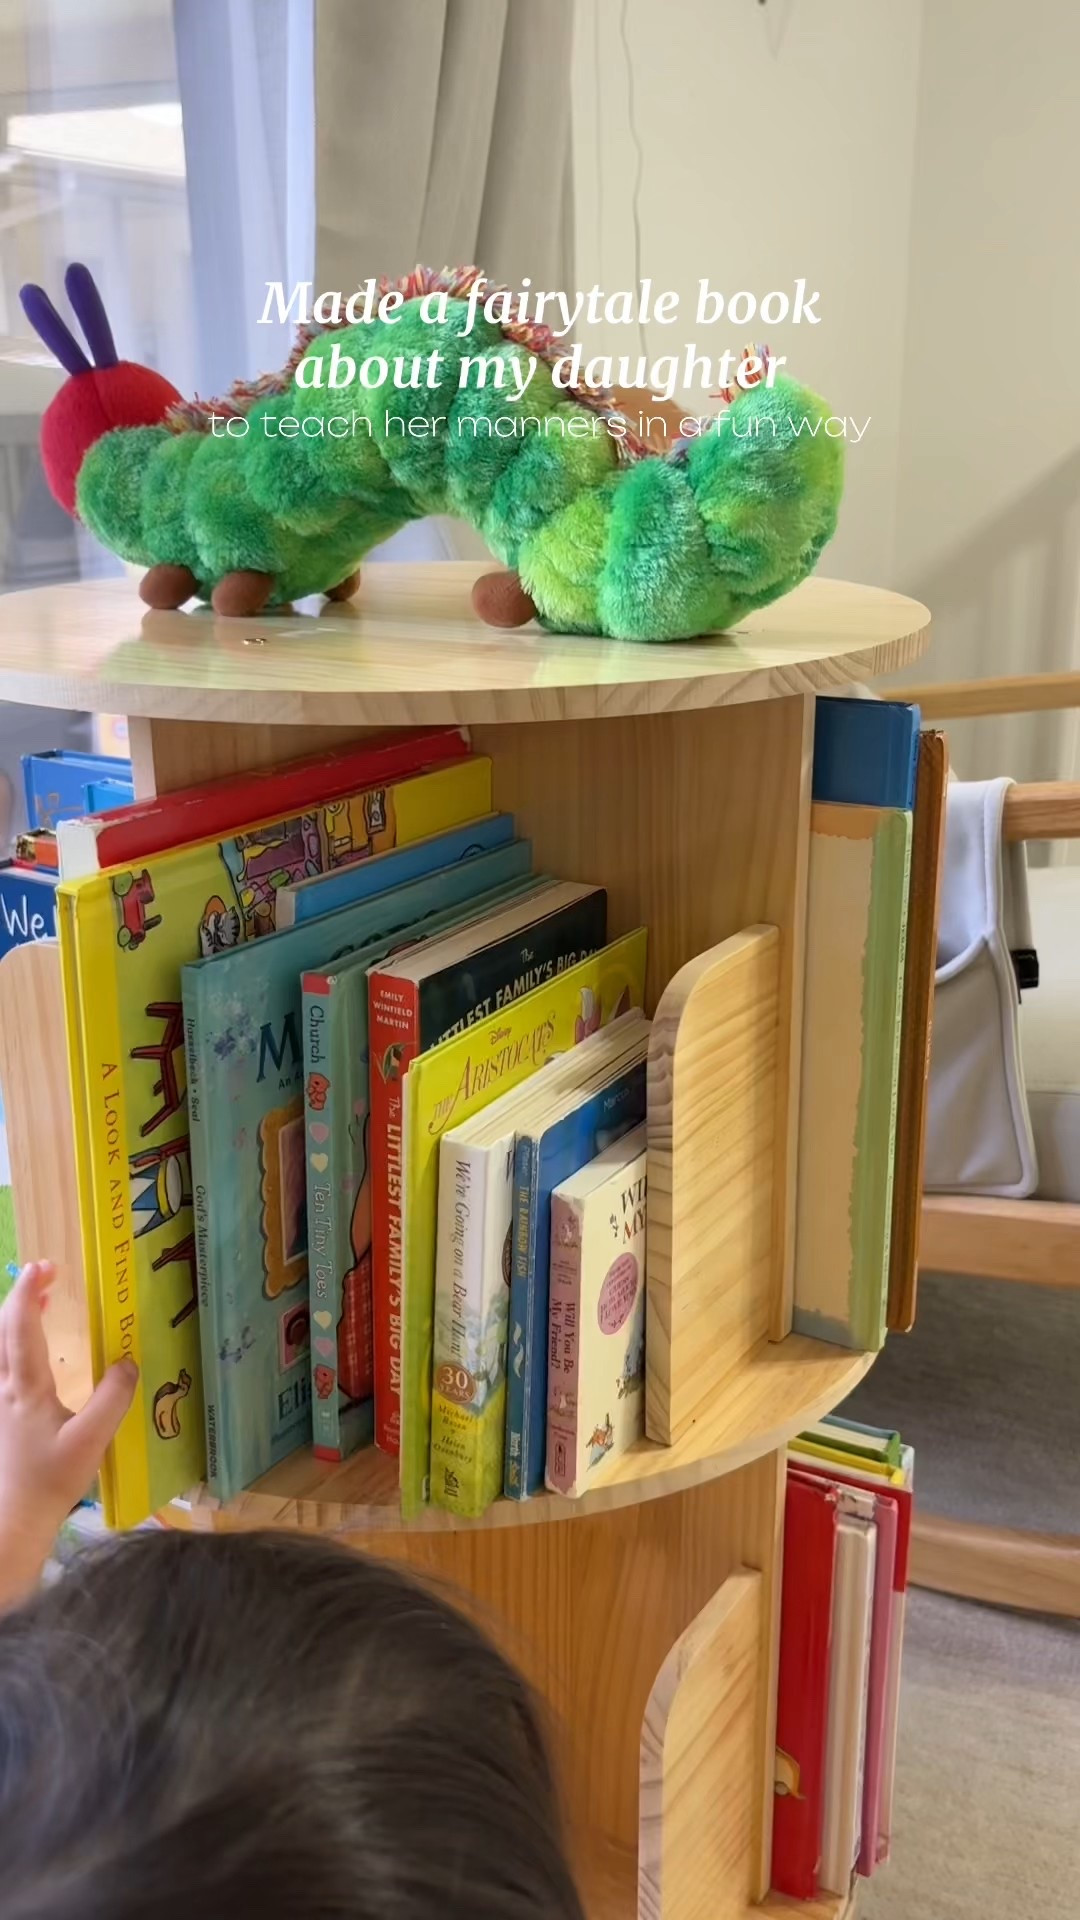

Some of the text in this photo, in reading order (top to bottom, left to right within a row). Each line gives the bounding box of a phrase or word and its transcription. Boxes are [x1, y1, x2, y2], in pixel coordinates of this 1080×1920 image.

[0, 893, 48, 941] We
[520, 947, 534, 964] The
[380, 989, 404, 1002] EMILY
[495, 959, 553, 1010] FAMILY'S
[556, 951, 577, 976] BIG
[372, 1000, 413, 1018] WINFIELD
[376, 1014, 409, 1029] MARTIN
[310, 1004, 326, 1064] Church
[102, 1063, 119, 1081] A
[104, 1089, 120, 1165] LOOK
[191, 1097, 201, 1122] Seal
[388, 1096, 401, 1118] The
[387, 1123, 402, 1210] LITTLEST
[110, 1178, 125, 1230] AND
[519, 1186, 530, 1204] THE
[196, 1185, 211, 1308] God's Masterpiece
[311, 1182, 334, 1299] Ten Tiny Toes
[518, 1207, 529, 1254] RAINBOW
[114, 1239, 131, 1304] FIND
[388, 1214, 402, 1307] FAMILY'S
[451, 1159, 471, 1358] We're Going on a Bear Hunt
[516, 1255, 528, 1278] FISH
[388, 1314, 401, 1349] BIG
[549, 1298, 562, 1369] My Friend?
[563, 1302, 576, 1375] Will You Be
[388, 1357, 401, 1397] DAY
[438, 1383, 474, 1401] YEARS
[441, 1366, 469, 1390] 30
[207, 1404, 218, 1478] WATERBROOK
